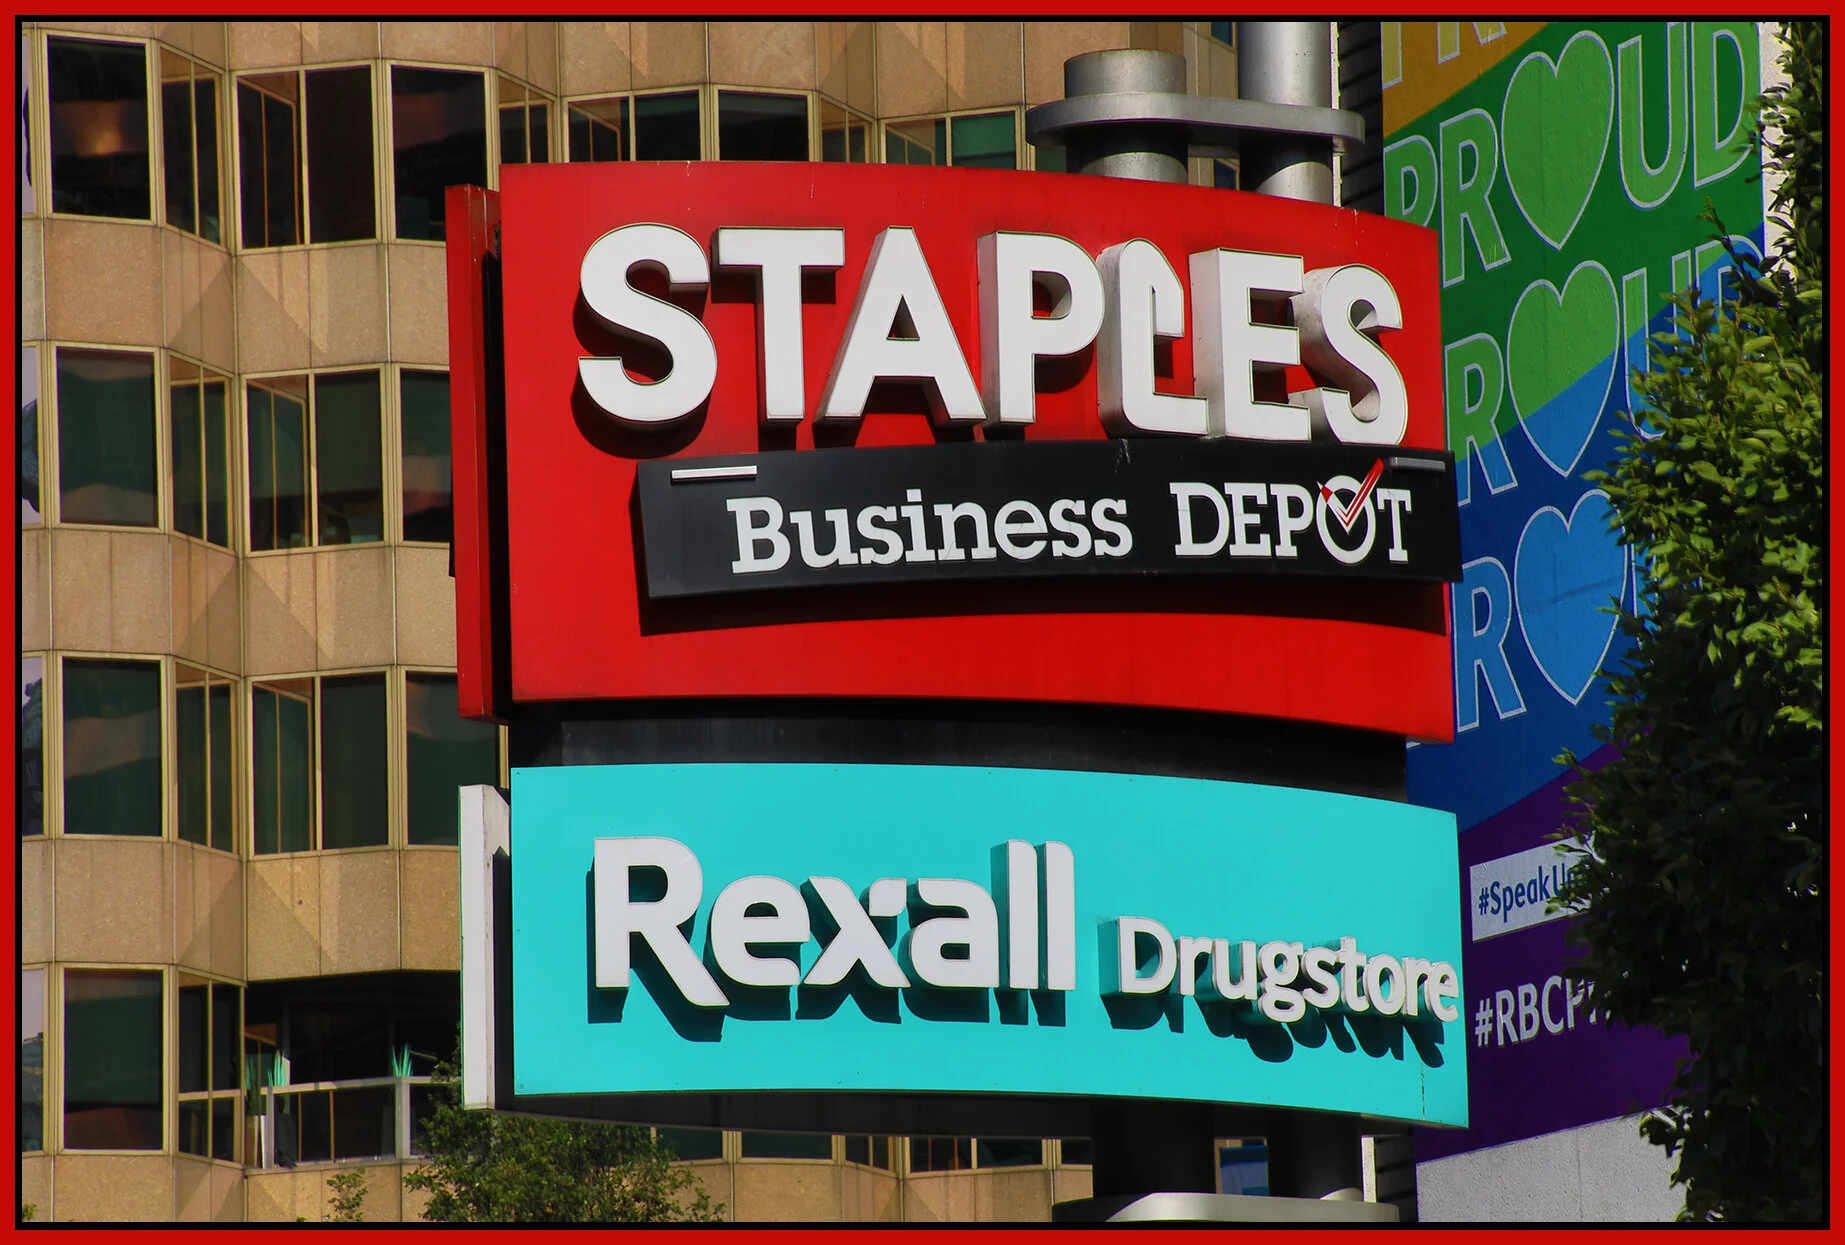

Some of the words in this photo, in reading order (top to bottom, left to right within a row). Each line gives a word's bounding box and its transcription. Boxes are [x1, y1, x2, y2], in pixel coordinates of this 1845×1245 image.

[578, 222, 1408, 446] STAPLES
[726, 488, 1133, 575] Business
[1169, 460, 1413, 565] DEPOT
[593, 836, 1076, 1007] Rexall
[1116, 916, 1460, 1024] Drugstore
[1475, 975, 1612, 1047] #RBCP
